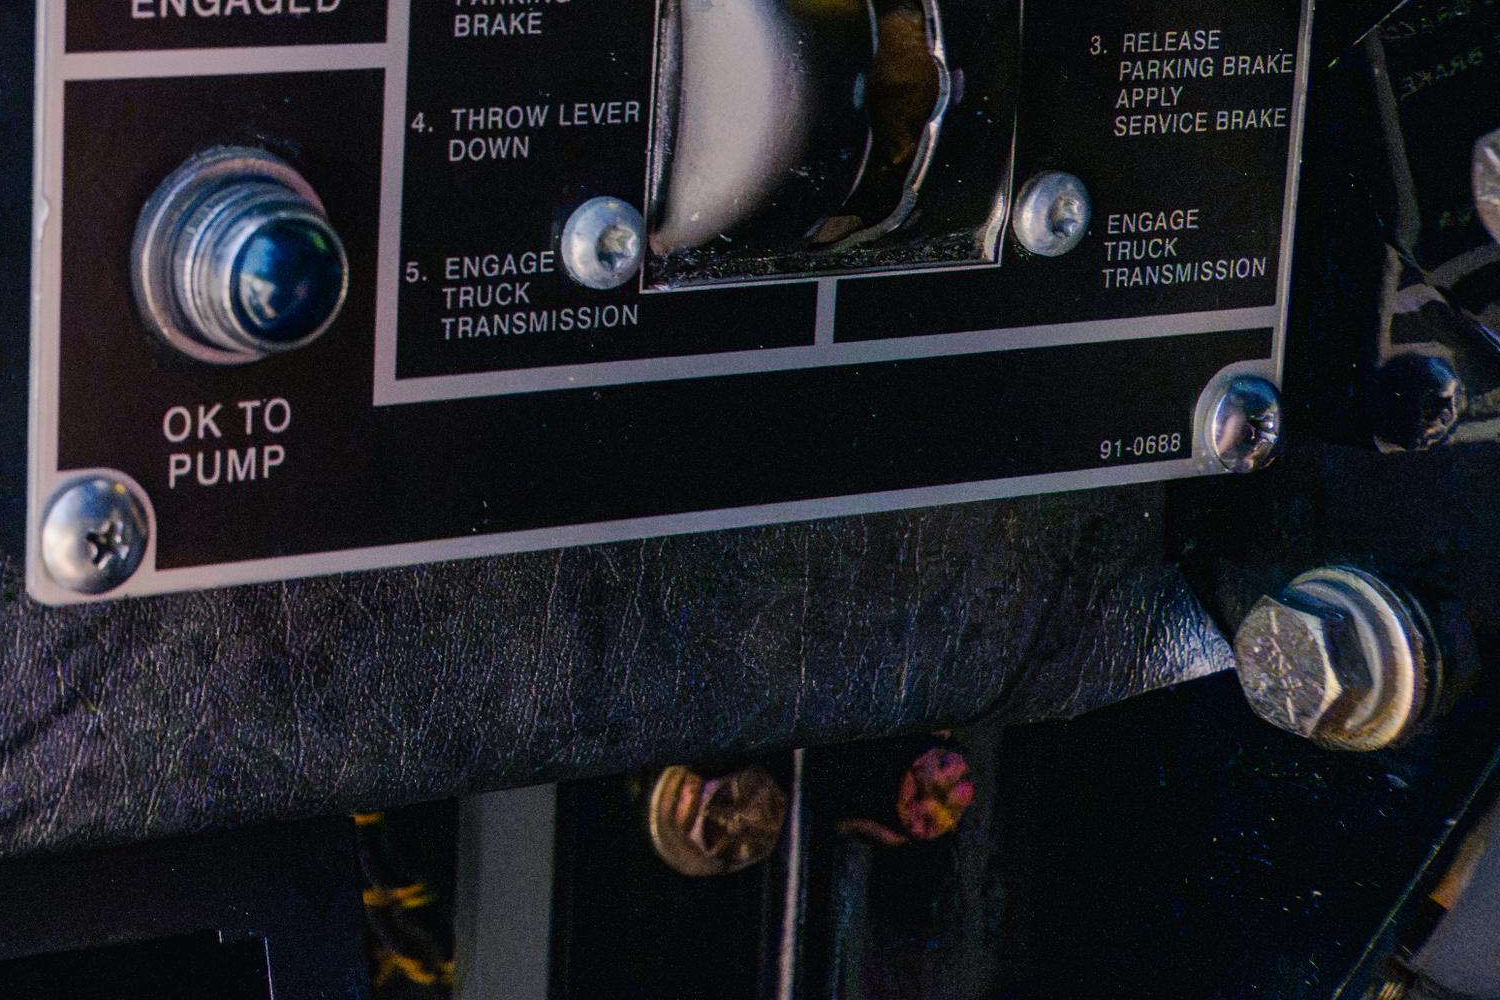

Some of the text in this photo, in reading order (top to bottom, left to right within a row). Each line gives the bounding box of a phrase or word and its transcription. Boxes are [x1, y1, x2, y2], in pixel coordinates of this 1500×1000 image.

[454, 12, 542, 37] BRAKE
[1090, 30, 1220, 55] 3. RELEASE
[1120, 54, 1292, 80] PARKING BRAKE
[1116, 86, 1183, 108] APPLY
[411, 101, 640, 132] 4. THROW LEVER
[1114, 108, 1286, 136] SERVICE BRAKE
[449, 136, 529, 161] DOWN
[1108, 209, 1199, 234] ENGAGE
[1104, 238, 1177, 261] TRUCK
[406, 250, 554, 282] 5. ENGAGE
[1103, 257, 1266, 287] TRANSMISSION
[442, 282, 530, 309] TRUCK
[441, 304, 637, 339] TRANSMISSION
[163, 398, 291, 442] OK TO
[169, 444, 286, 488] PUMP
